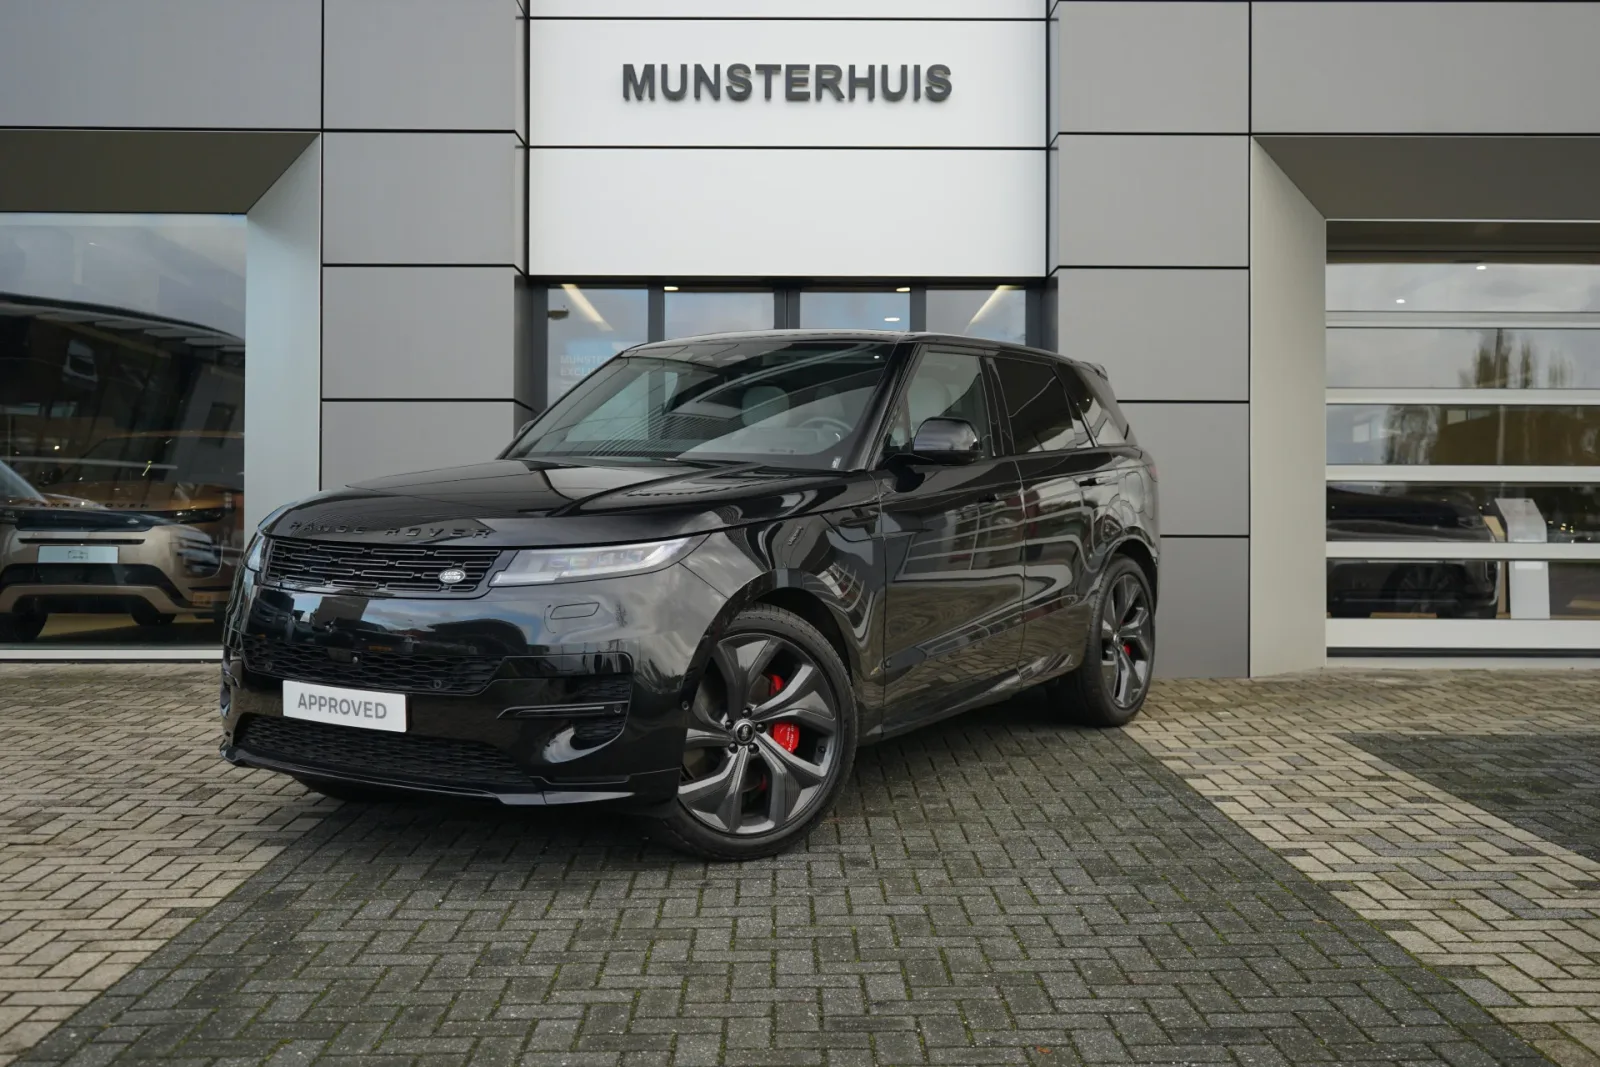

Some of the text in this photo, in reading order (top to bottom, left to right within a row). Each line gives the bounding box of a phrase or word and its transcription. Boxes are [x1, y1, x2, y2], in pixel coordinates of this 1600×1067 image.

[622, 63, 953, 101] MUNSTERHUIS
[289, 521, 491, 539] RANGE ROVER
[297, 692, 387, 720] APPROVED
